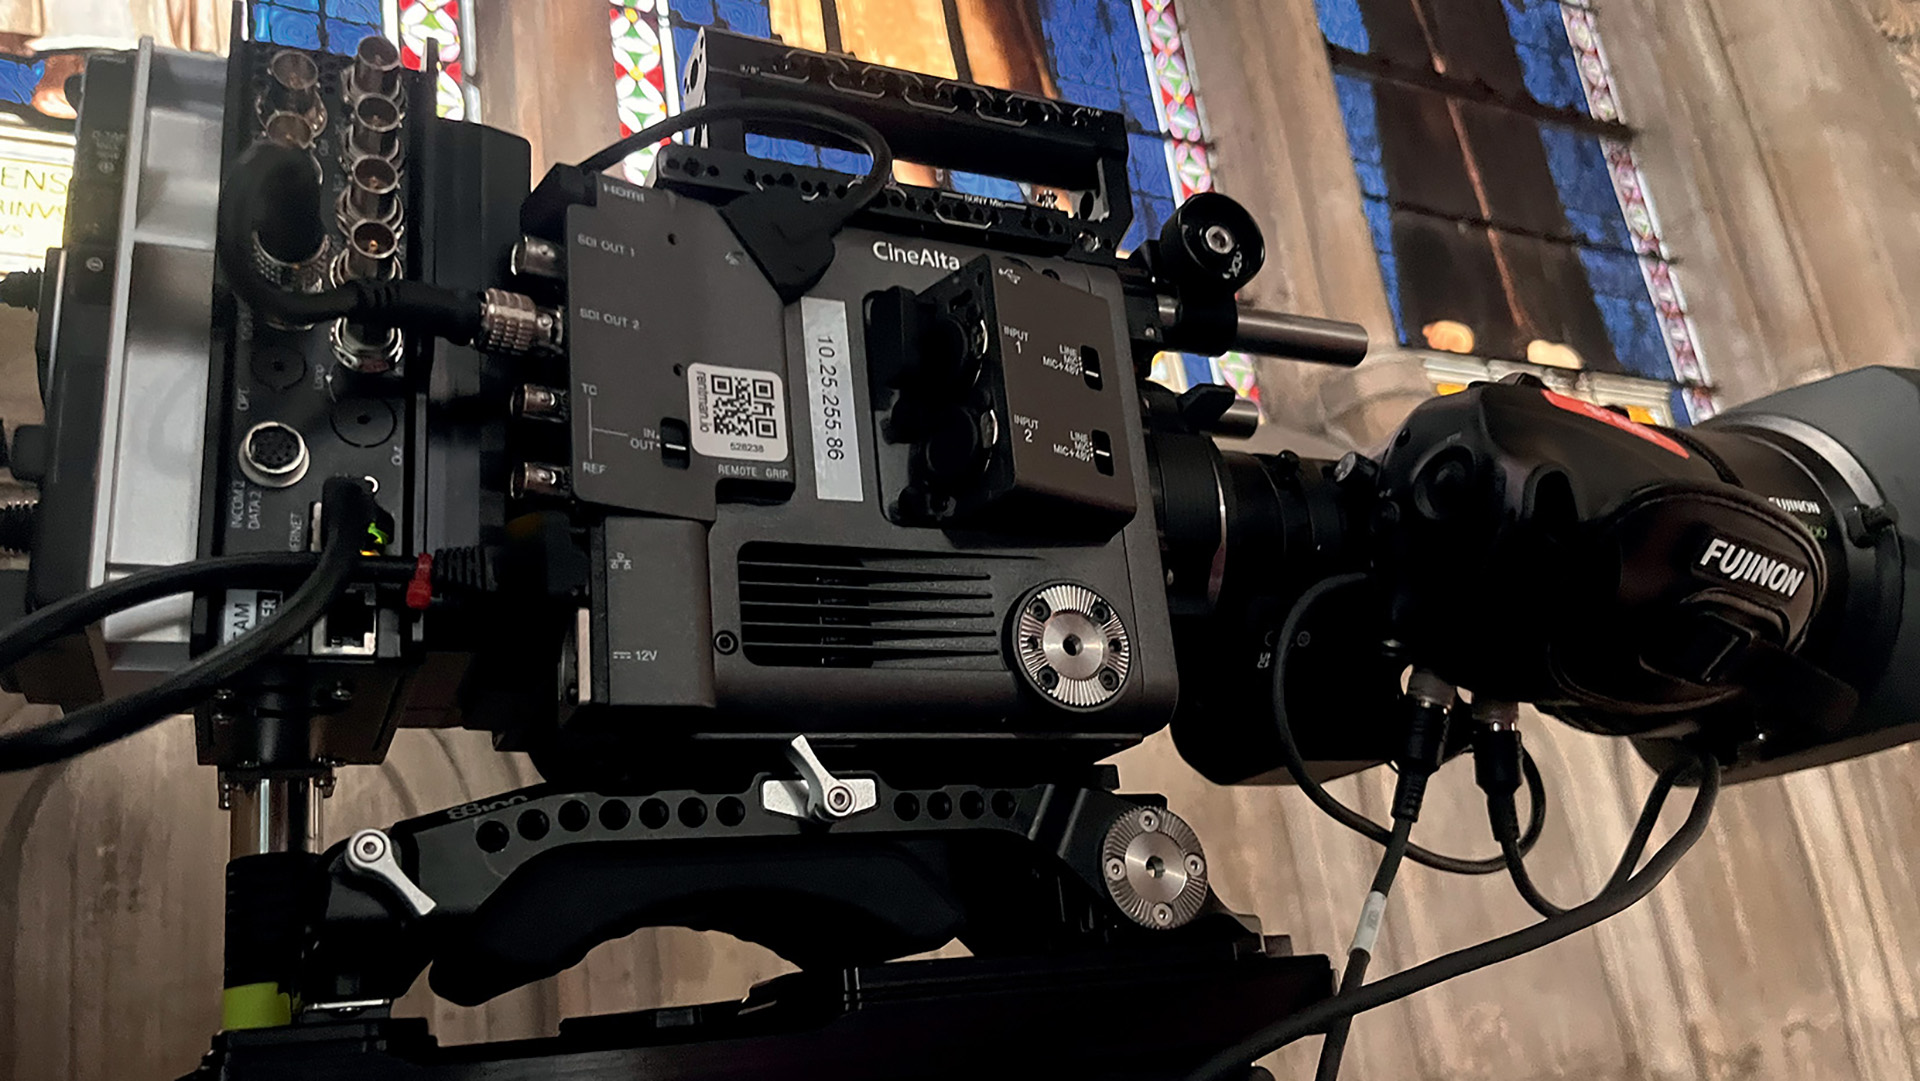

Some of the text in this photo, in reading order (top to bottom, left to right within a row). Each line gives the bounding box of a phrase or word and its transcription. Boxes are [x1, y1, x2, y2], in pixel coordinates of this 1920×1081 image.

[578, 233, 635, 258] SDI OUT 1
[873, 241, 960, 270] CineAlta
[580, 307, 641, 332] SDI OUT 2
[1003, 325, 1029, 342] INPUT
[1015, 340, 1022, 355] 1
[818, 335, 844, 460] 10.25.255.86
[1013, 413, 1039, 430] INPUT
[642, 427, 656, 439] IN
[1024, 428, 1033, 443] 2
[629, 437, 655, 450] OUT
[582, 461, 607, 475] REF
[717, 463, 789, 479] REMOTE GRIP
[1700, 538, 1805, 597] FUJINON
[635, 649, 658, 662] 12V
